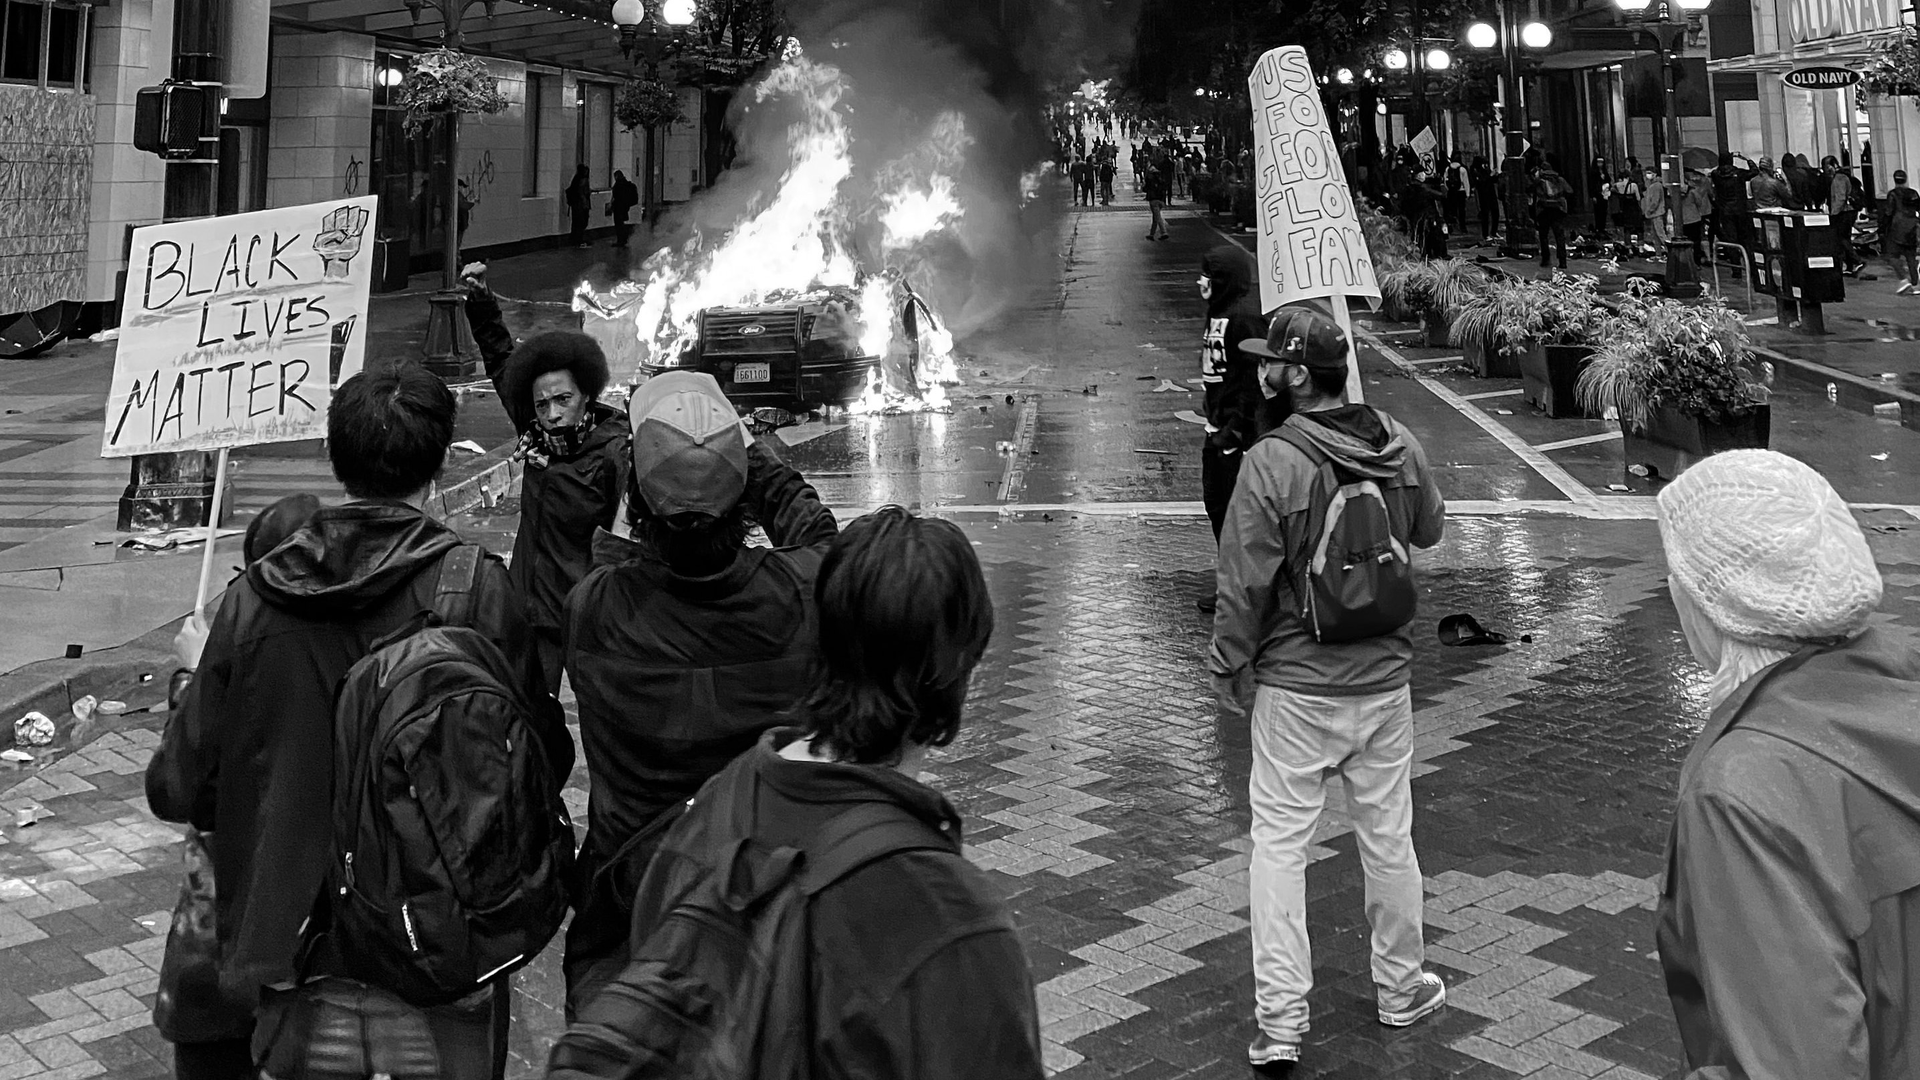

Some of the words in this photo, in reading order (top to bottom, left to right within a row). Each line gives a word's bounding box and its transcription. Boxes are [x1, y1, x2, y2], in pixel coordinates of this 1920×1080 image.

[1788, 0, 1833, 43] OLD
[1792, 73, 1816, 84] OLD
[1819, 72, 1852, 83] NAVY
[1266, 94, 1330, 135] FO
[143, 231, 301, 310] BLACK
[197, 296, 330, 348] LIVES
